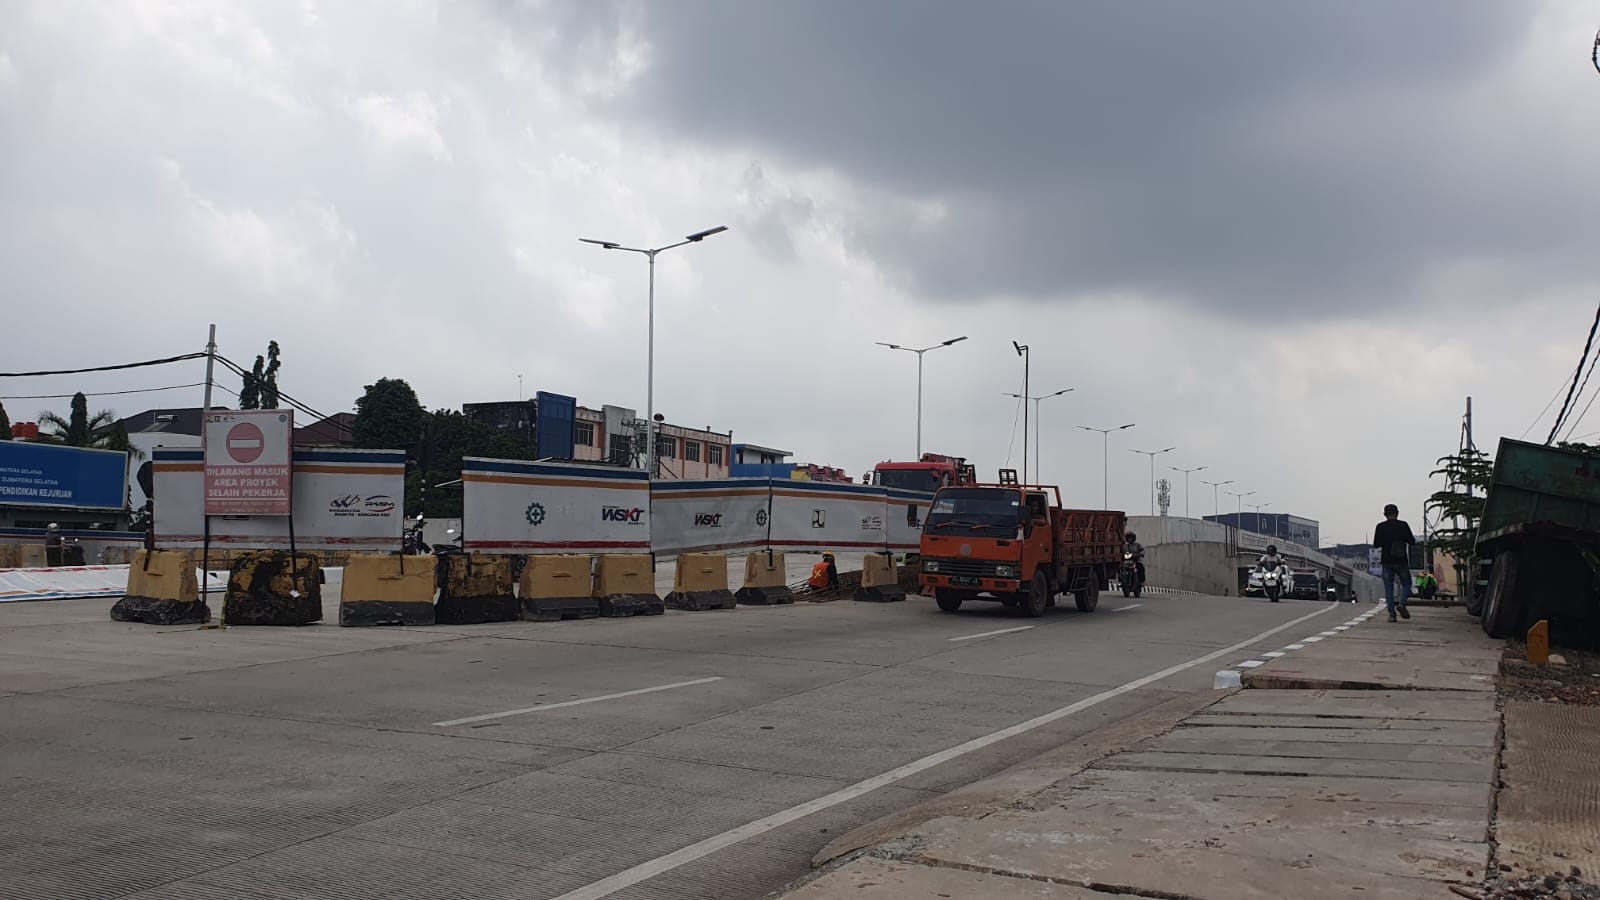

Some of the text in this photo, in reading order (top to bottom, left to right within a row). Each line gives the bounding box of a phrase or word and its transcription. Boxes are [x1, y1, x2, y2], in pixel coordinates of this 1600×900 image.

[206, 467, 288, 476] DILARANG MASUK
[214, 478, 279, 487] AREA PROYEK
[39, 488, 72, 498] KEJURUAN
[208, 488, 285, 497] SELAIN PEKERJA
[602, 508, 644, 521] WSKT
[695, 513, 722, 525] WSKT
